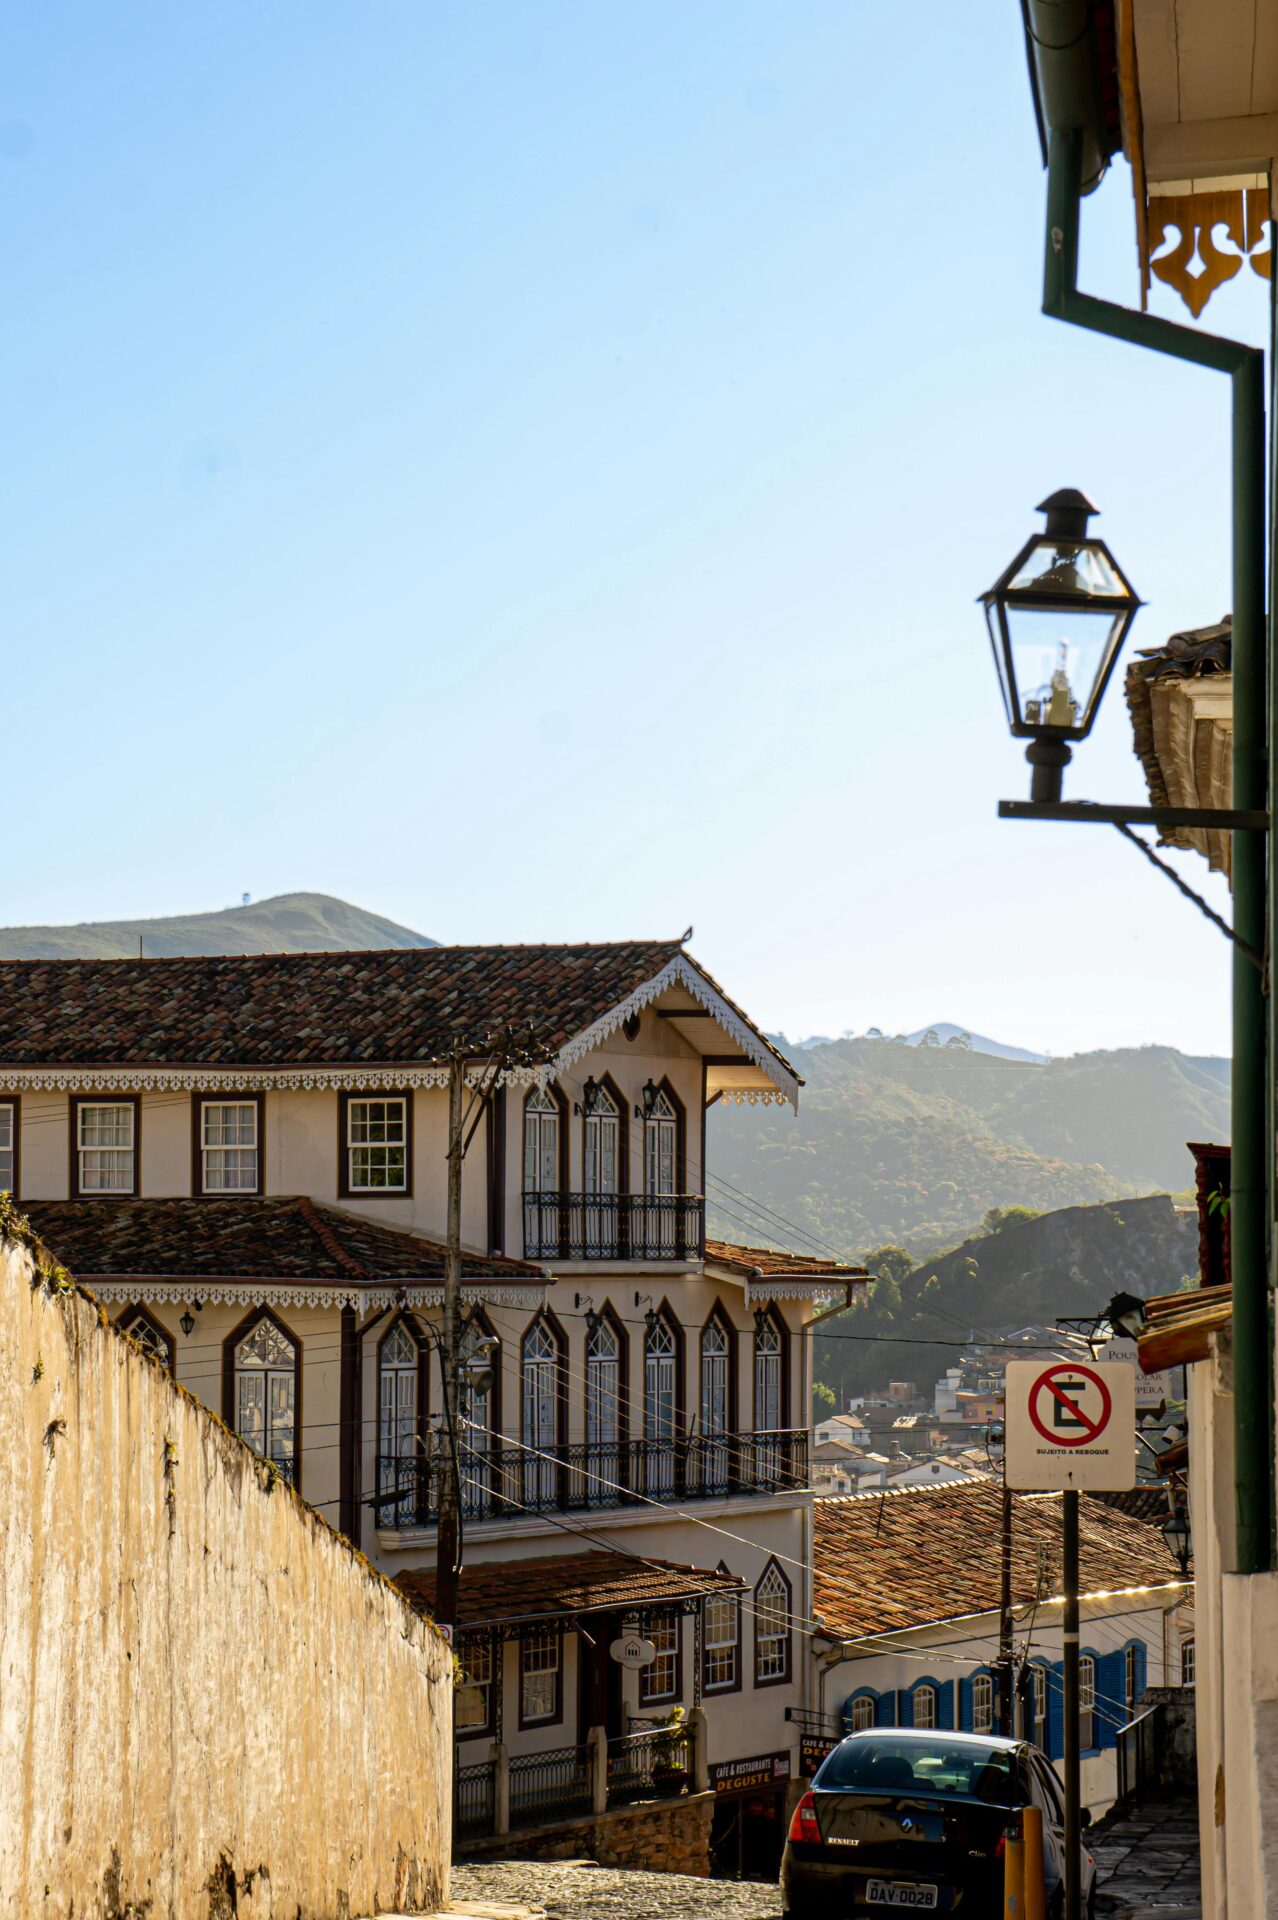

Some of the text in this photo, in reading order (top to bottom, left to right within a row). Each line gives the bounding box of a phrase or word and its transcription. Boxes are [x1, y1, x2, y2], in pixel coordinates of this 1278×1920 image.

[1108, 1351, 1137, 1359] POUS
[1135, 1373, 1162, 1381] OLAR
[1135, 1386, 1164, 1394] PERA
[730, 1764, 735, 1776] &
[736, 1759, 771, 1775] RESTAURANTE
[716, 1772, 770, 1792] DEGUSTE
[828, 1837, 859, 1846] RENAULT
